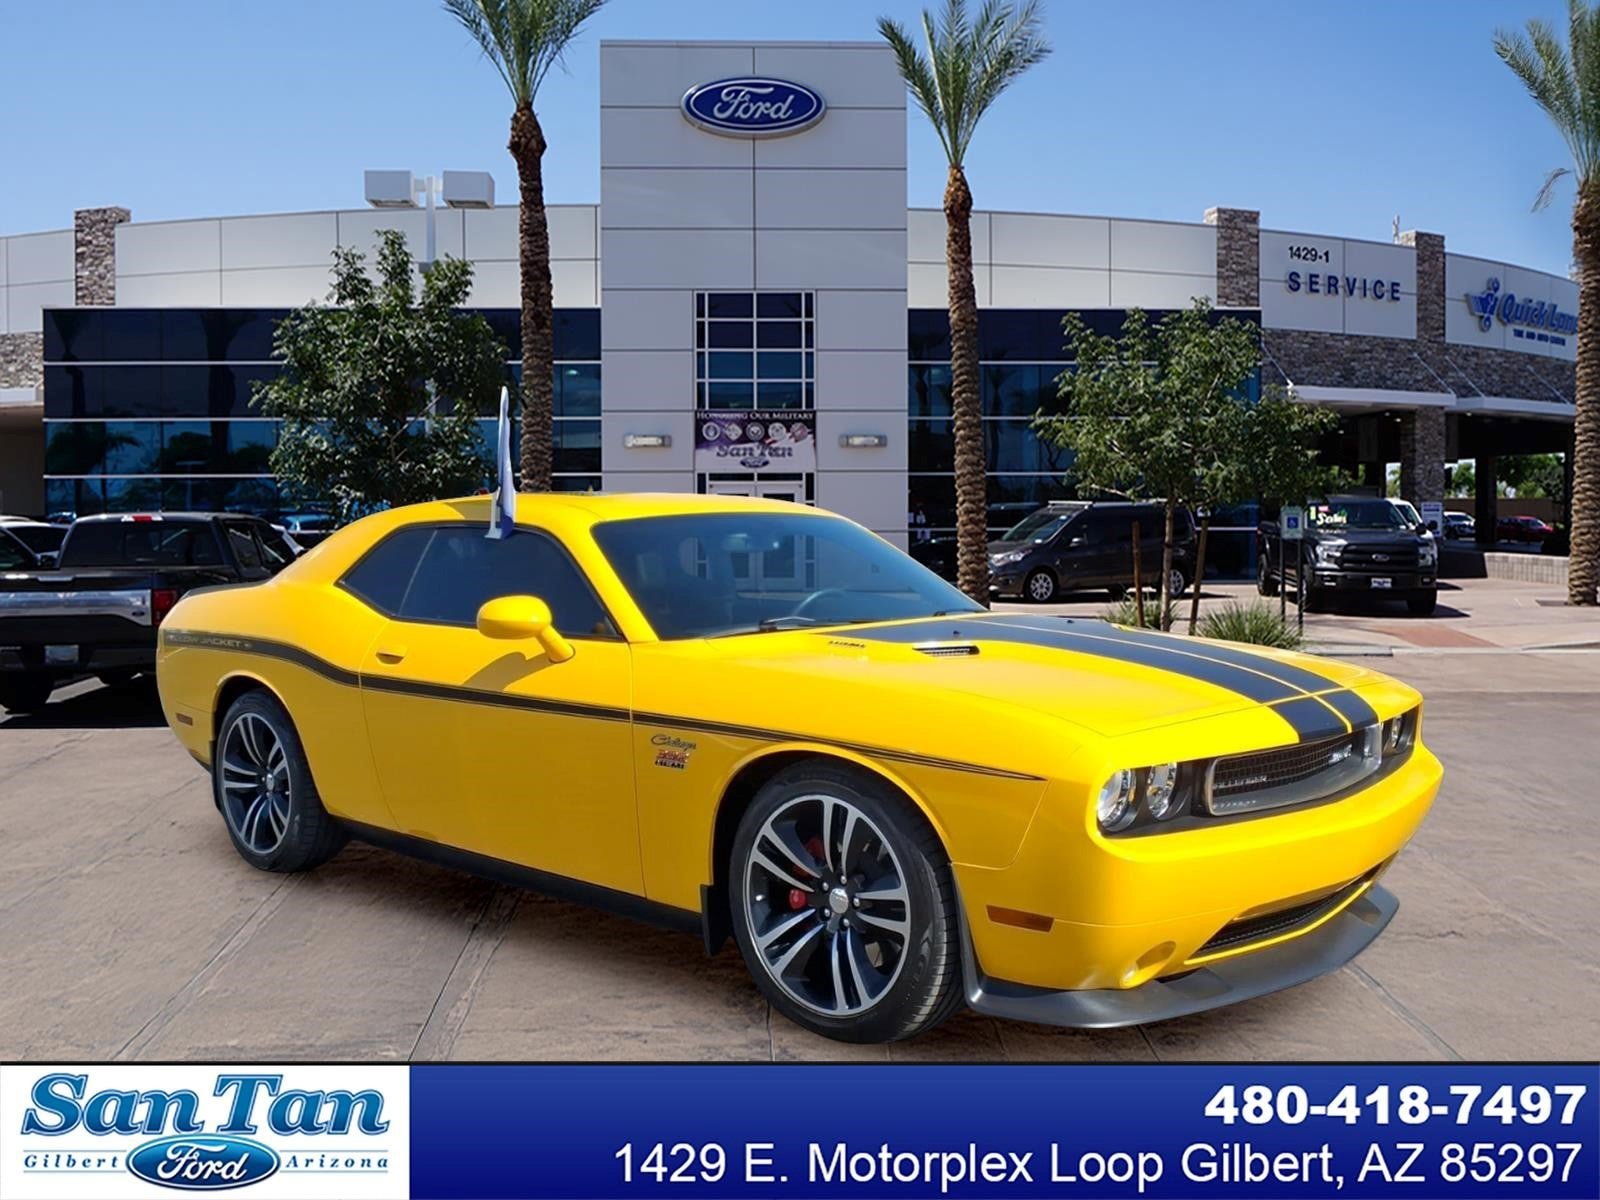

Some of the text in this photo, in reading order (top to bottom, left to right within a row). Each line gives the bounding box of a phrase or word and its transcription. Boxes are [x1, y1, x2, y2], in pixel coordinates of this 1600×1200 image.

[713, 86, 795, 119] Ford
[1288, 246, 1329, 263] 1429-1
[1288, 271, 1401, 301] SERVICE
[1502, 293, 1578, 333] Quick Lan
[716, 444, 793, 458] San Tan
